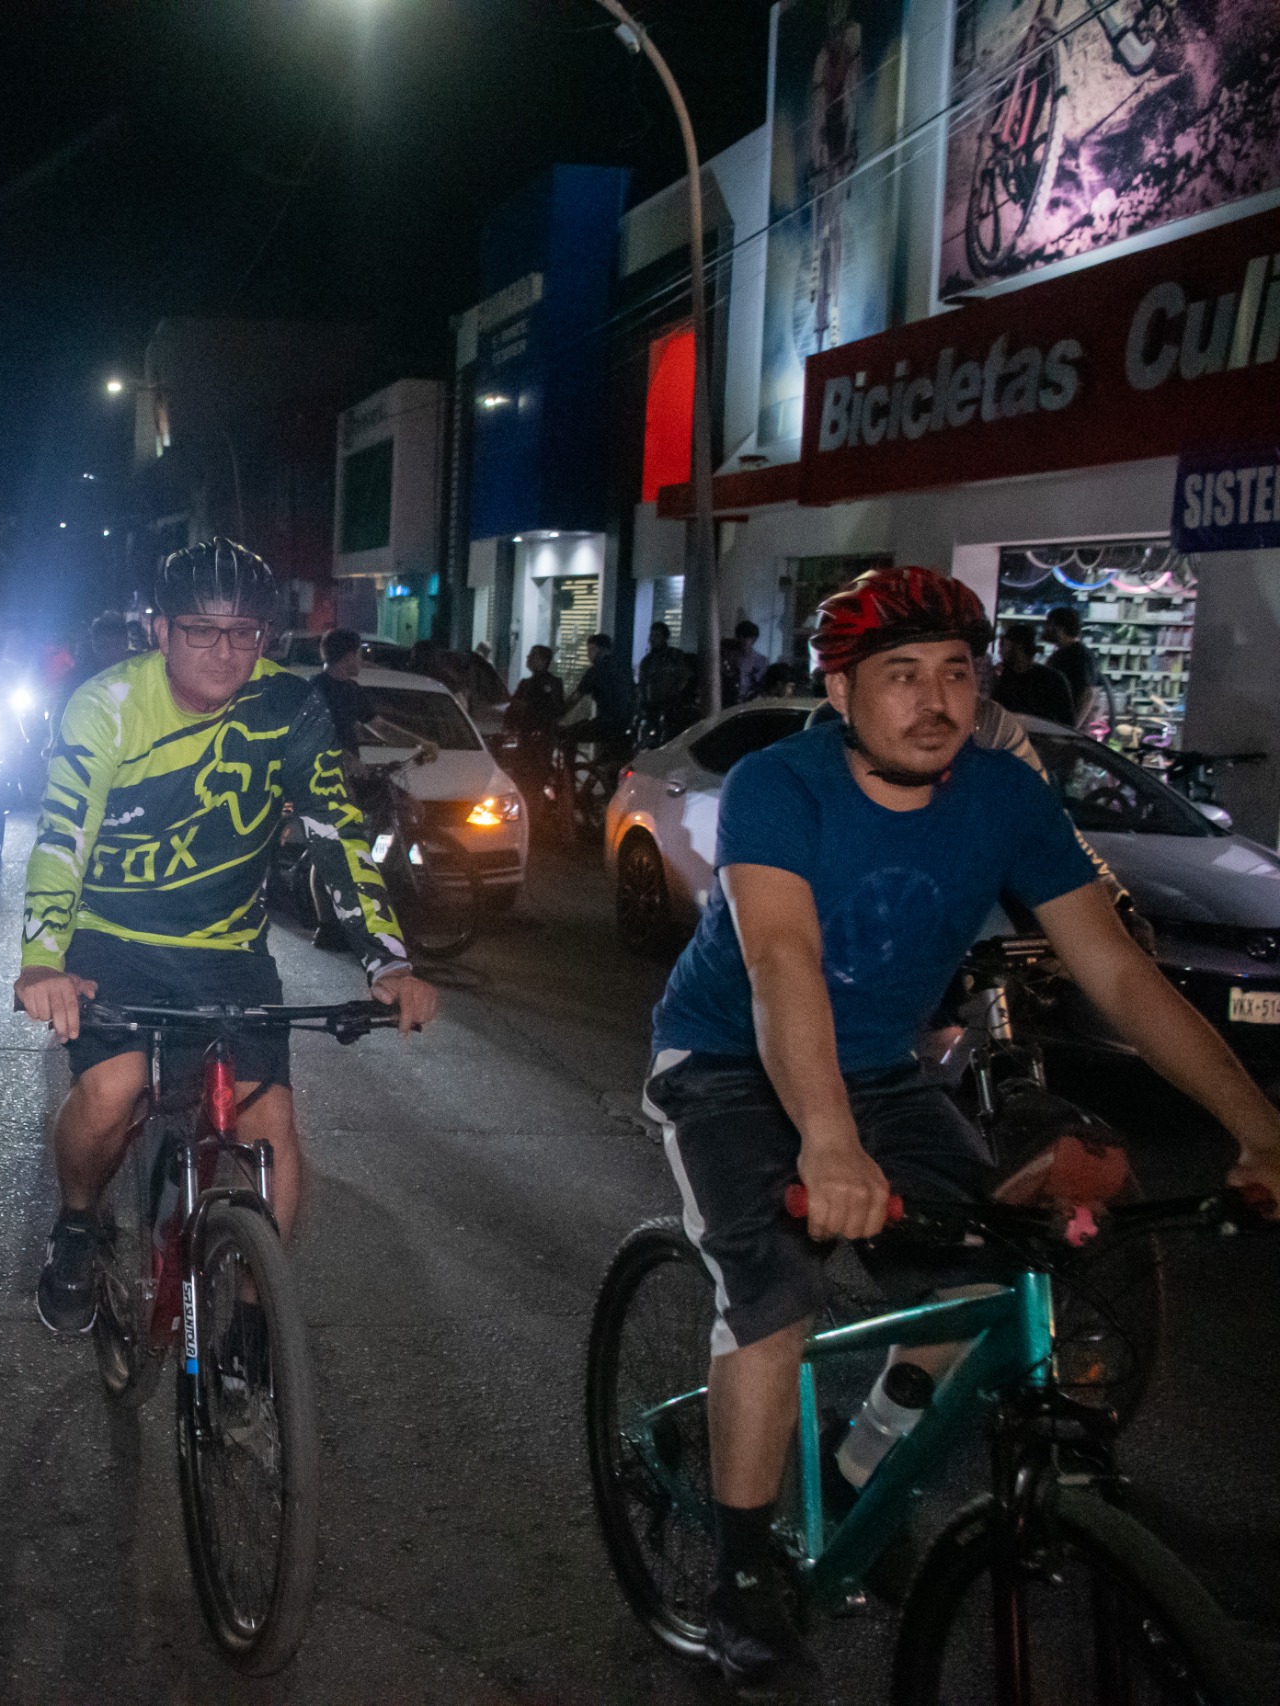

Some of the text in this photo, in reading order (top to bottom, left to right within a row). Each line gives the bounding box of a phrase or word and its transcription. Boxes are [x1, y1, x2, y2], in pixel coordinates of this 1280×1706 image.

[818, 332, 1083, 452] Bicicletas
[1183, 465, 1280, 529] SISTE
[93, 825, 200, 883] FOX
